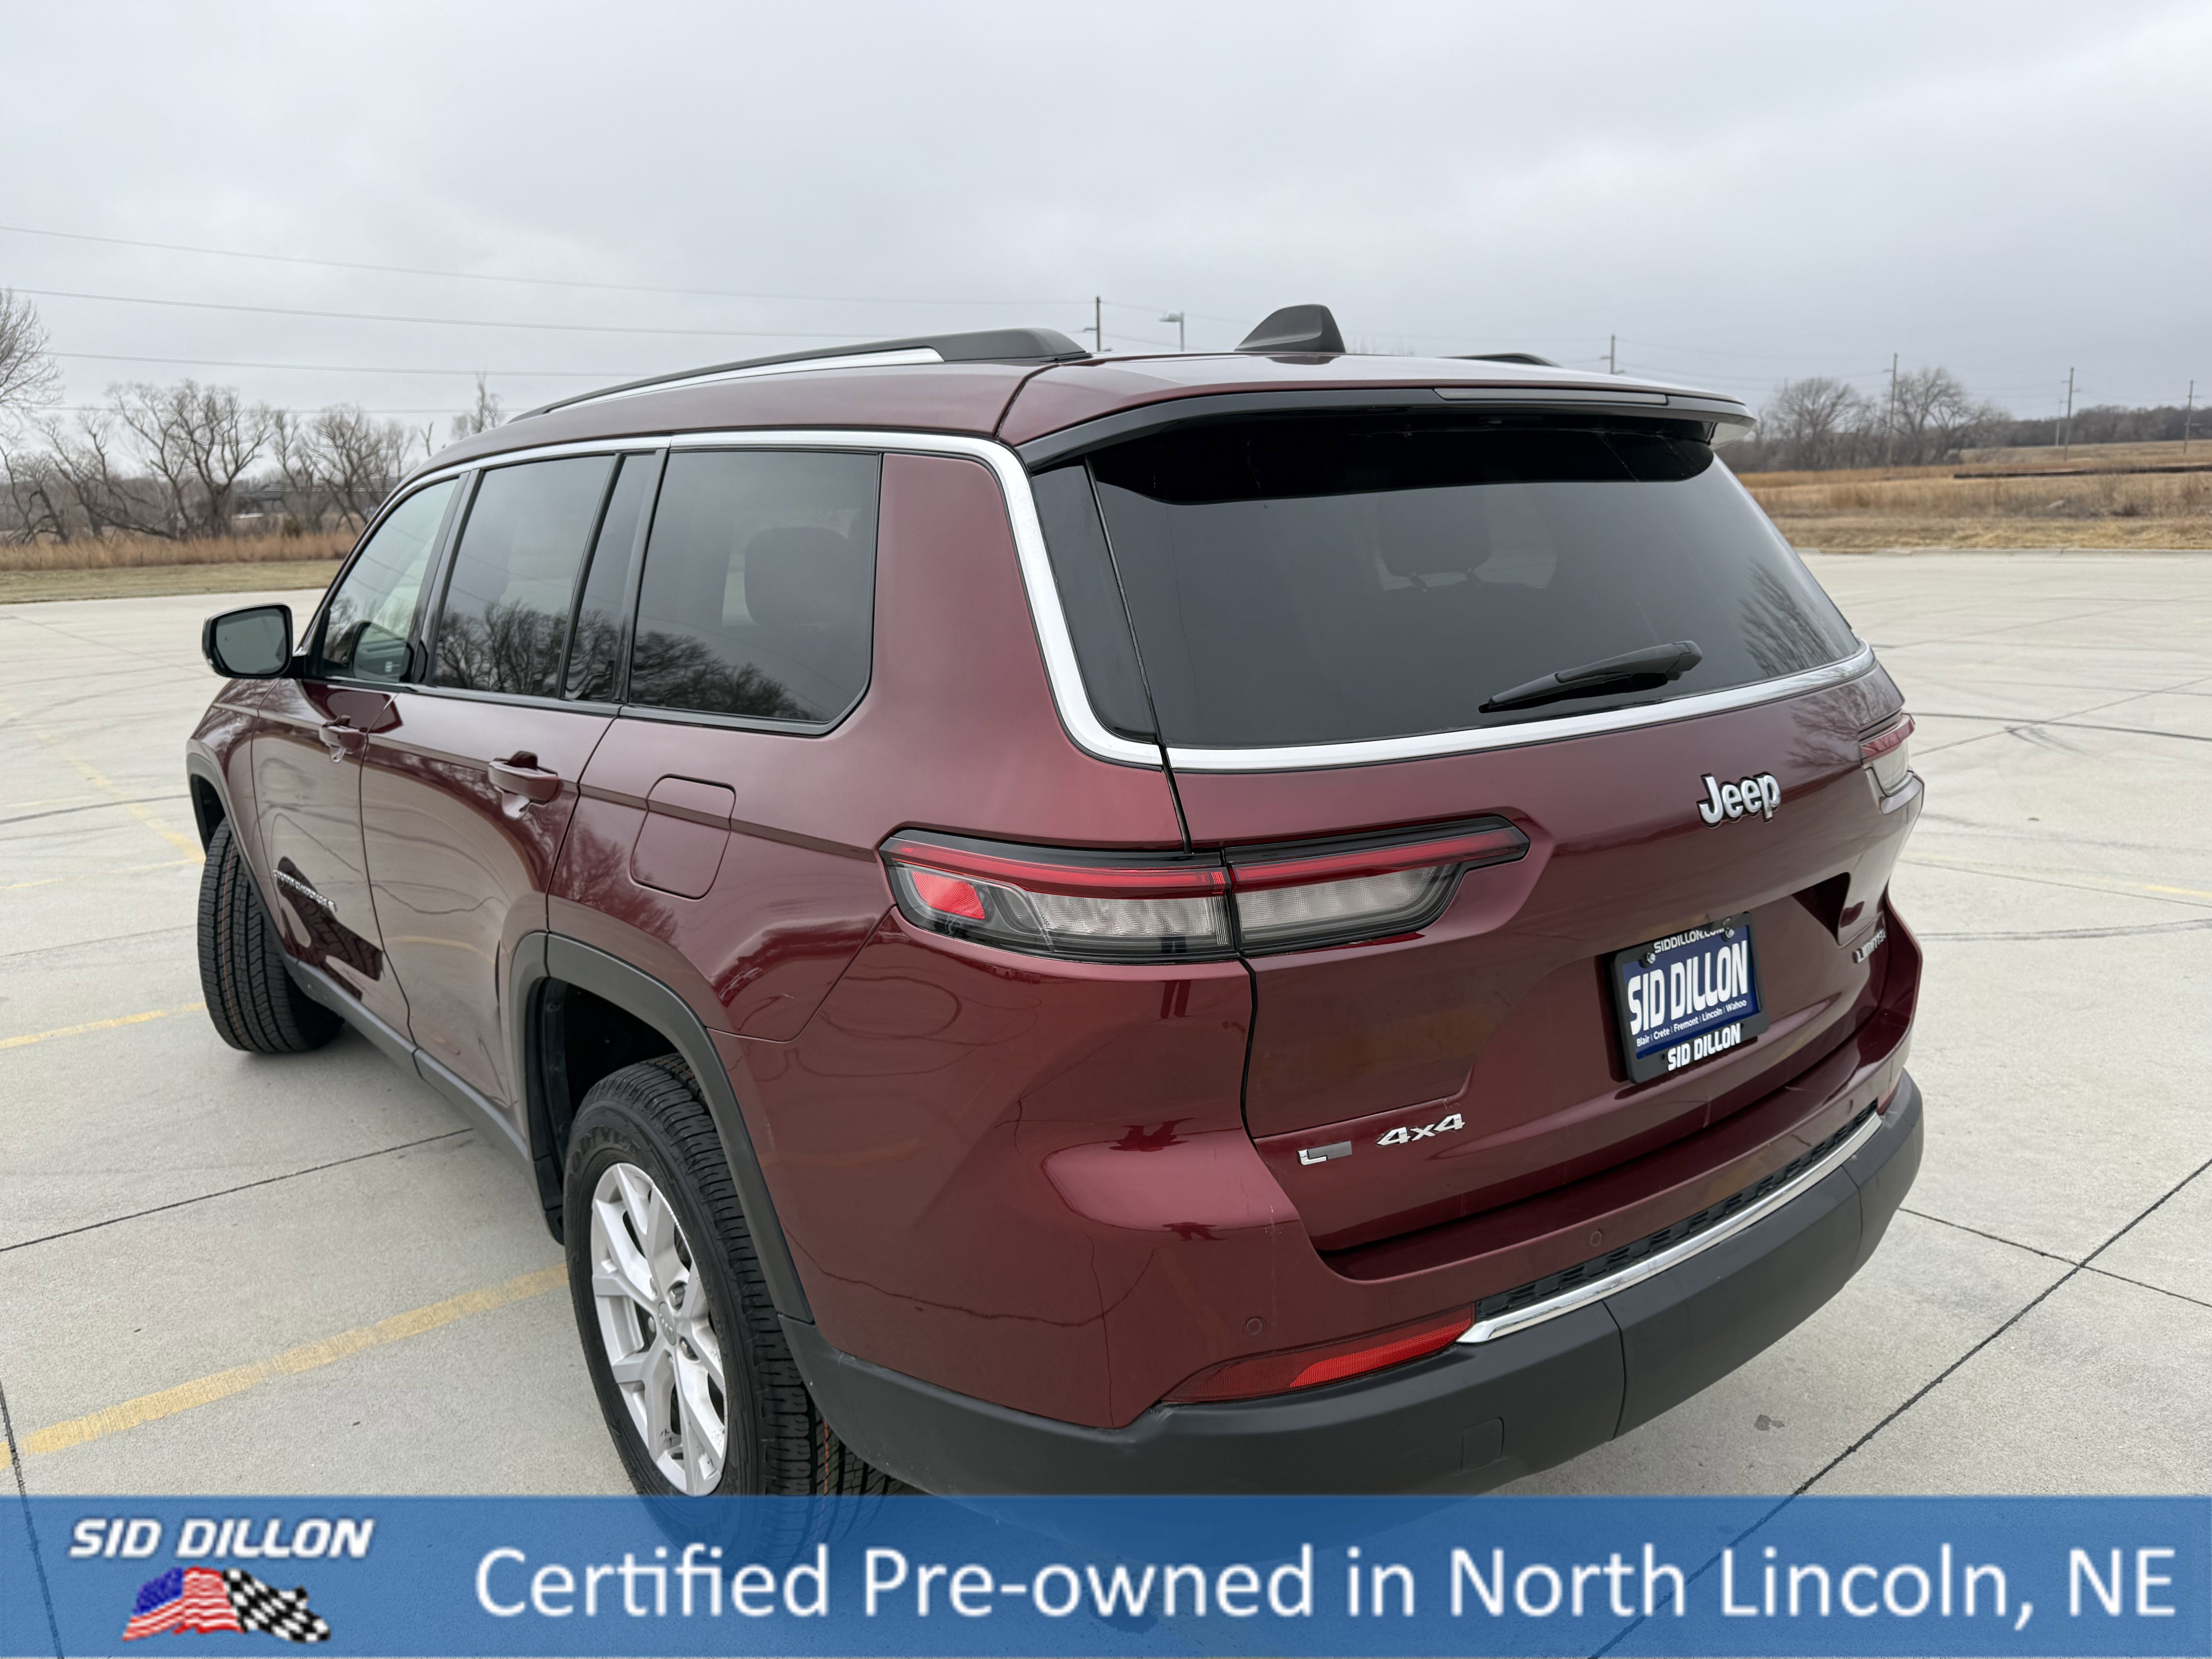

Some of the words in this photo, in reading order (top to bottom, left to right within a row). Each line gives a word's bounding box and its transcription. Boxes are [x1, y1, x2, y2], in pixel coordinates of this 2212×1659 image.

[1698, 774, 1781, 824] Jeep
[1628, 969, 1665, 1036] SID
[1670, 940, 1748, 1021] DILLON
[1636, 1035, 1650, 1047] Blair
[1654, 1028, 1670, 1040] Crete
[1673, 1016, 1699, 1032] Fremont
[1701, 1007, 1723, 1022] Lincoln
[1725, 1000, 1747, 1012] Wahoo
[1668, 1043, 1690, 1071] SID
[1694, 1022, 1741, 1061] DILLON
[1376, 1113, 1465, 1146] 4x4
